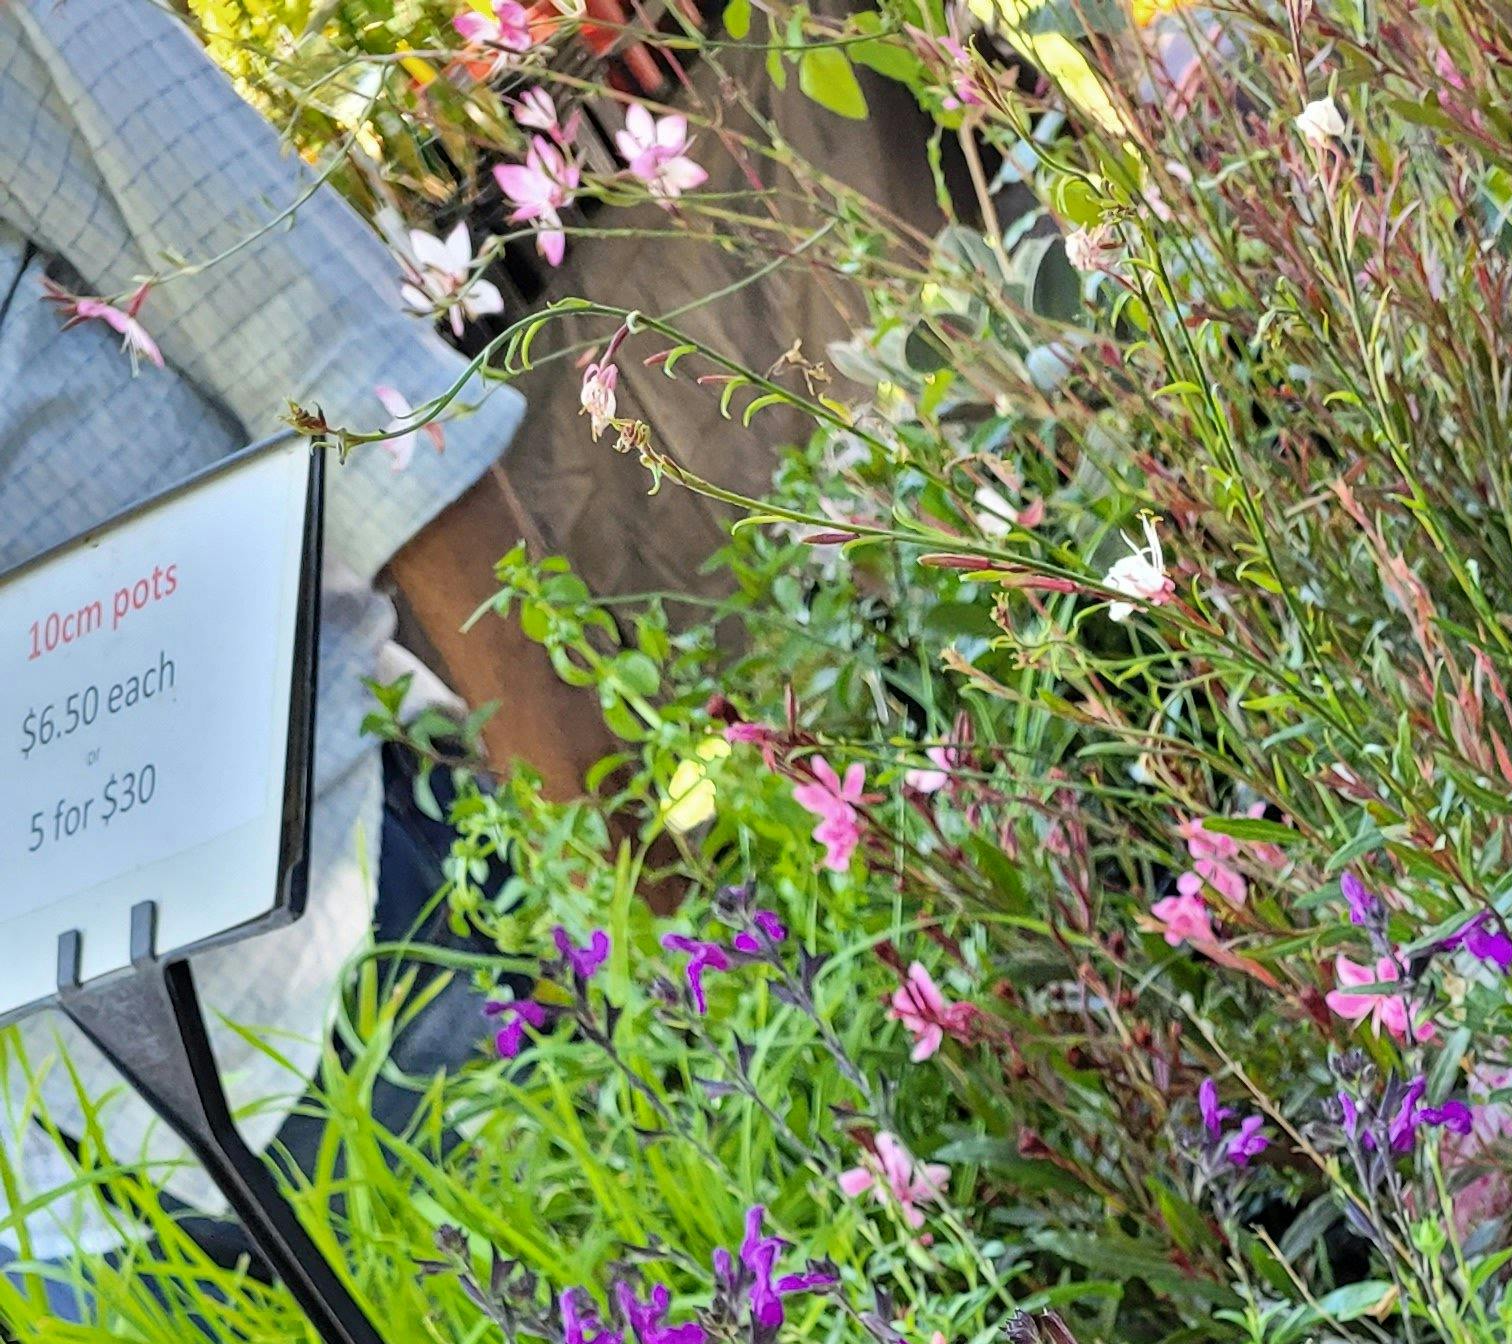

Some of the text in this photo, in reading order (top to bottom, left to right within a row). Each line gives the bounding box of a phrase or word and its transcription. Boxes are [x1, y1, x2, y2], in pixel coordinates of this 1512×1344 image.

[27, 563, 178, 661] 10cm pots
[21, 650, 176, 760] $6.50 each
[28, 763, 156, 852] 5 for $30
